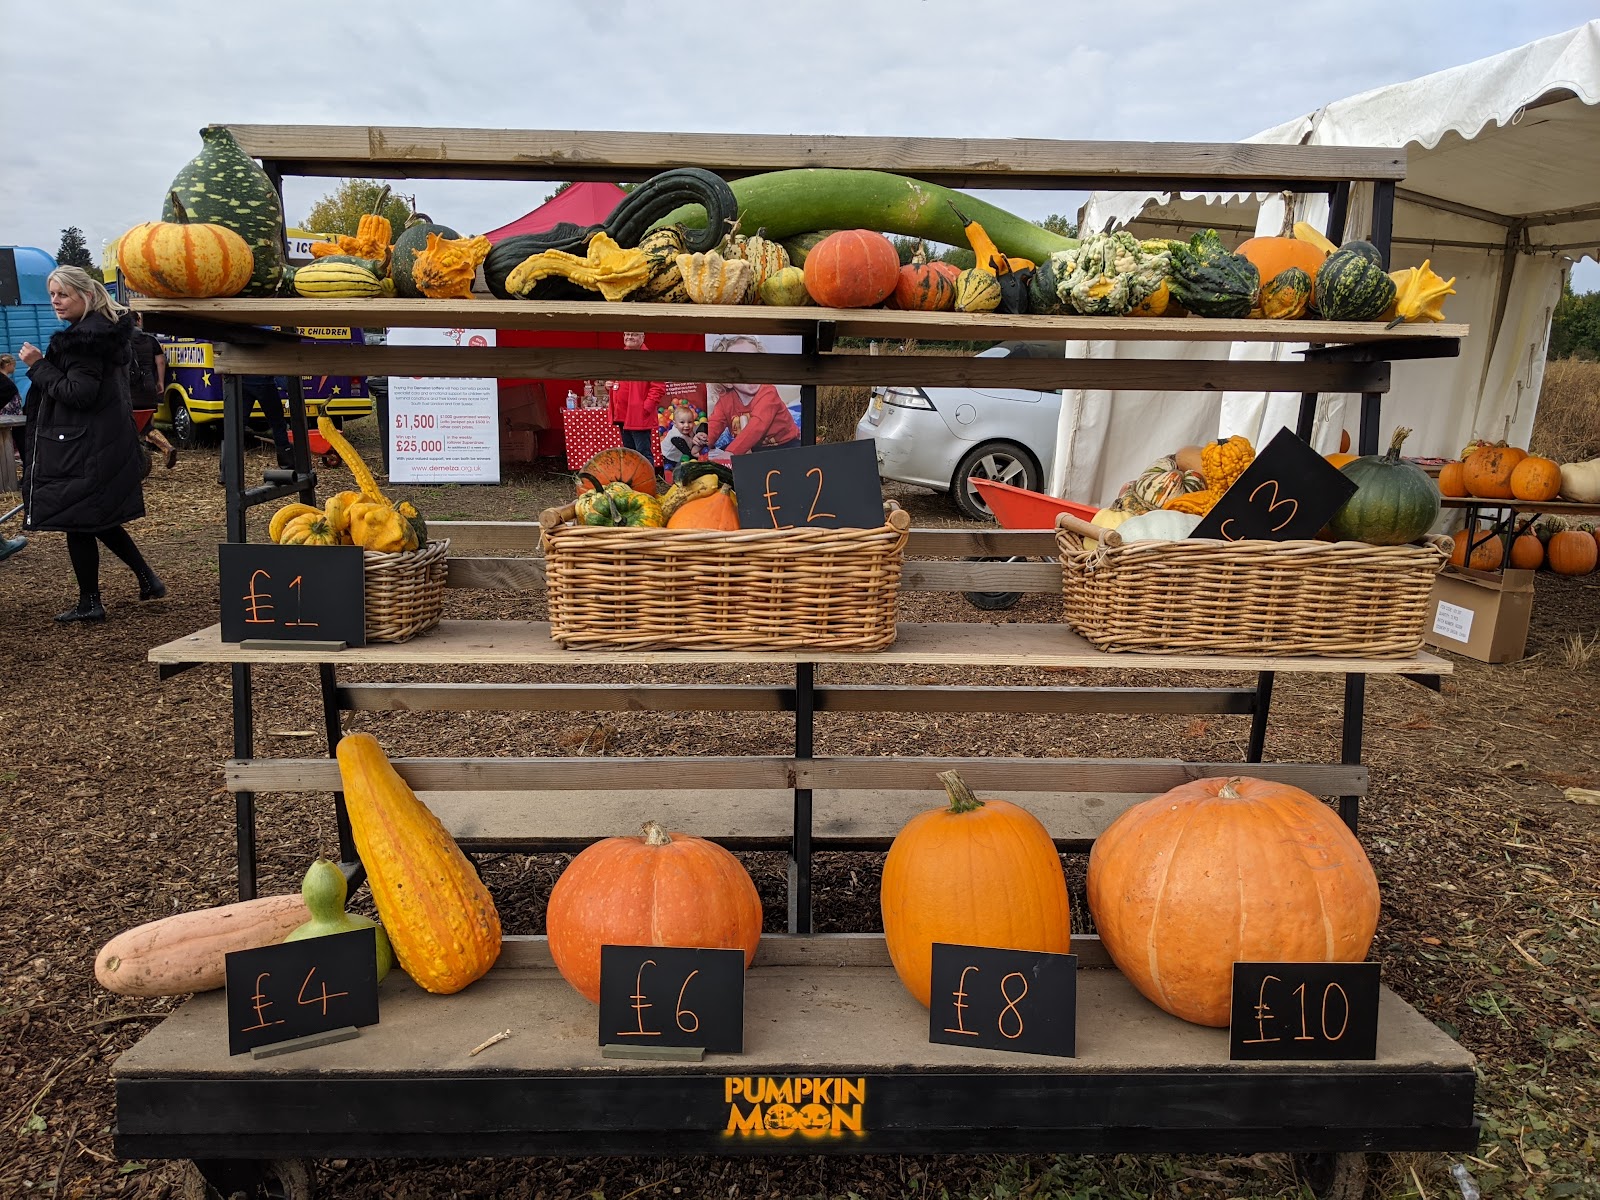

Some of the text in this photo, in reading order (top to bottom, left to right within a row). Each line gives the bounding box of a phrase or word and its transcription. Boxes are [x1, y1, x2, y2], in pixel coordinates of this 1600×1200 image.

[307, 328, 347, 336] CHILDREN
[174, 346, 205, 364] TEMPTATION
[396, 414, 434, 430] £1,500
[396, 440, 442, 453] £25,000
[1243, 975, 1350, 1043] £10
[725, 1077, 866, 1104] PUMPKIN
[725, 1102, 863, 1137] MOON
